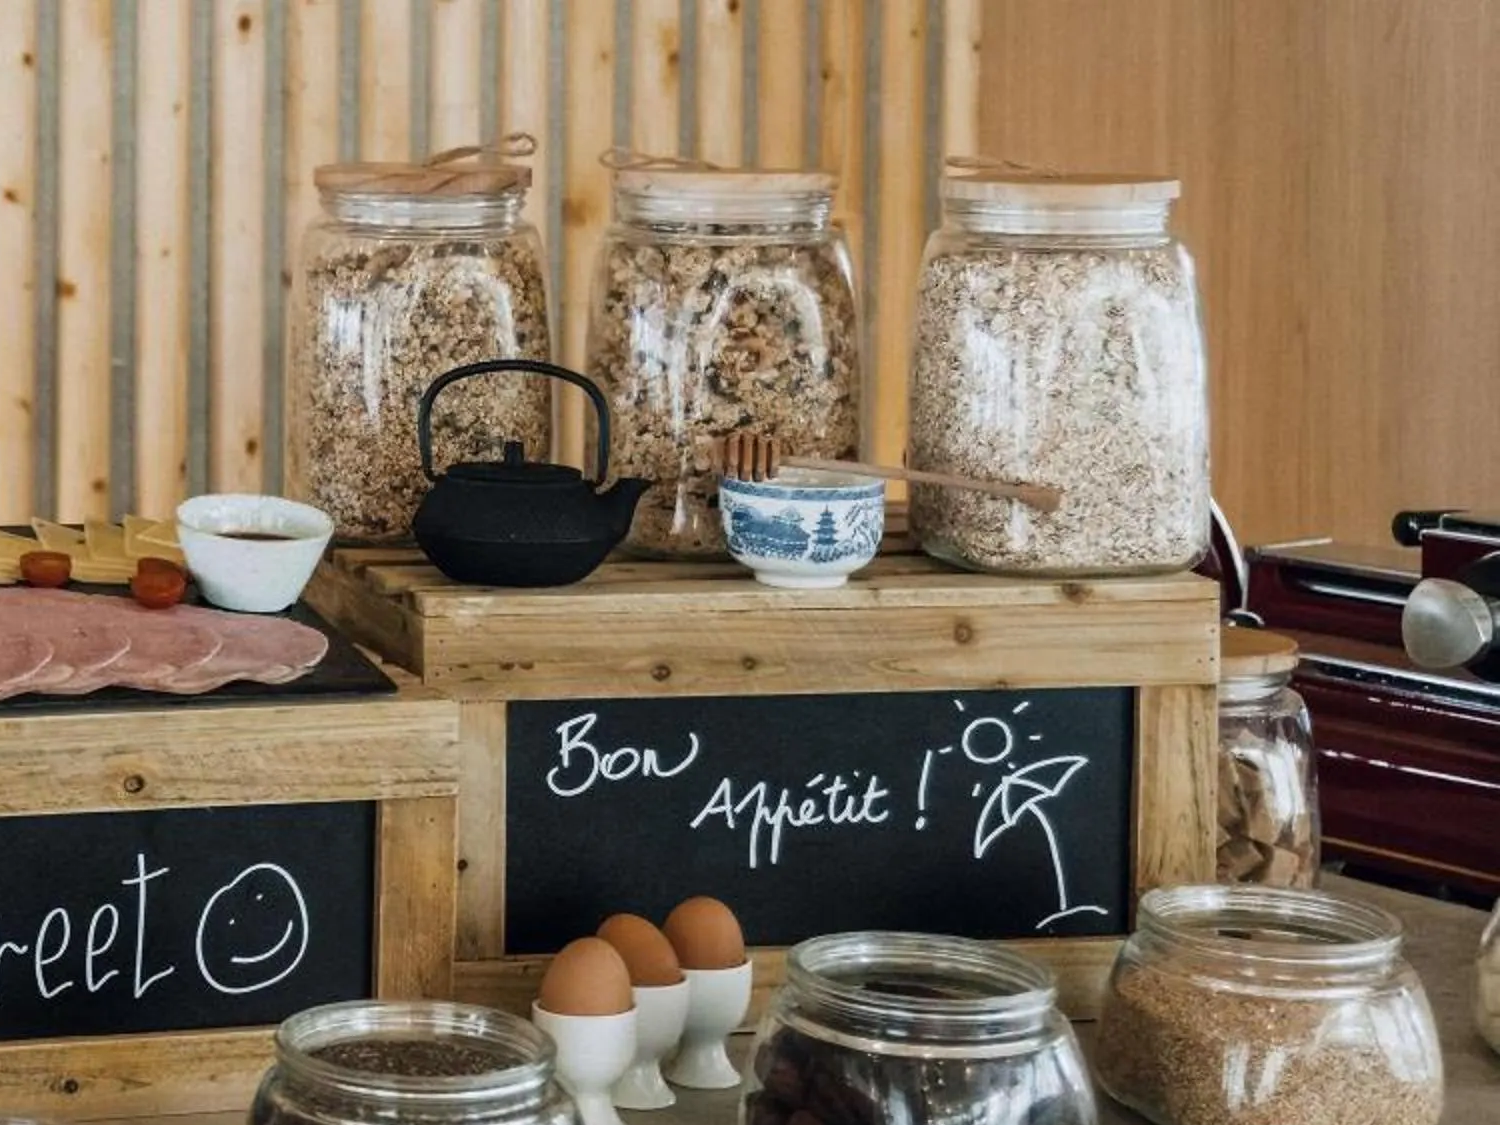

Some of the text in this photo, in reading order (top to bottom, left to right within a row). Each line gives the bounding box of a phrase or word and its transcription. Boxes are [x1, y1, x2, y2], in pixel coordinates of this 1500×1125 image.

[547, 713, 699, 797] Bon
[690, 749, 934, 868] Appétit !
